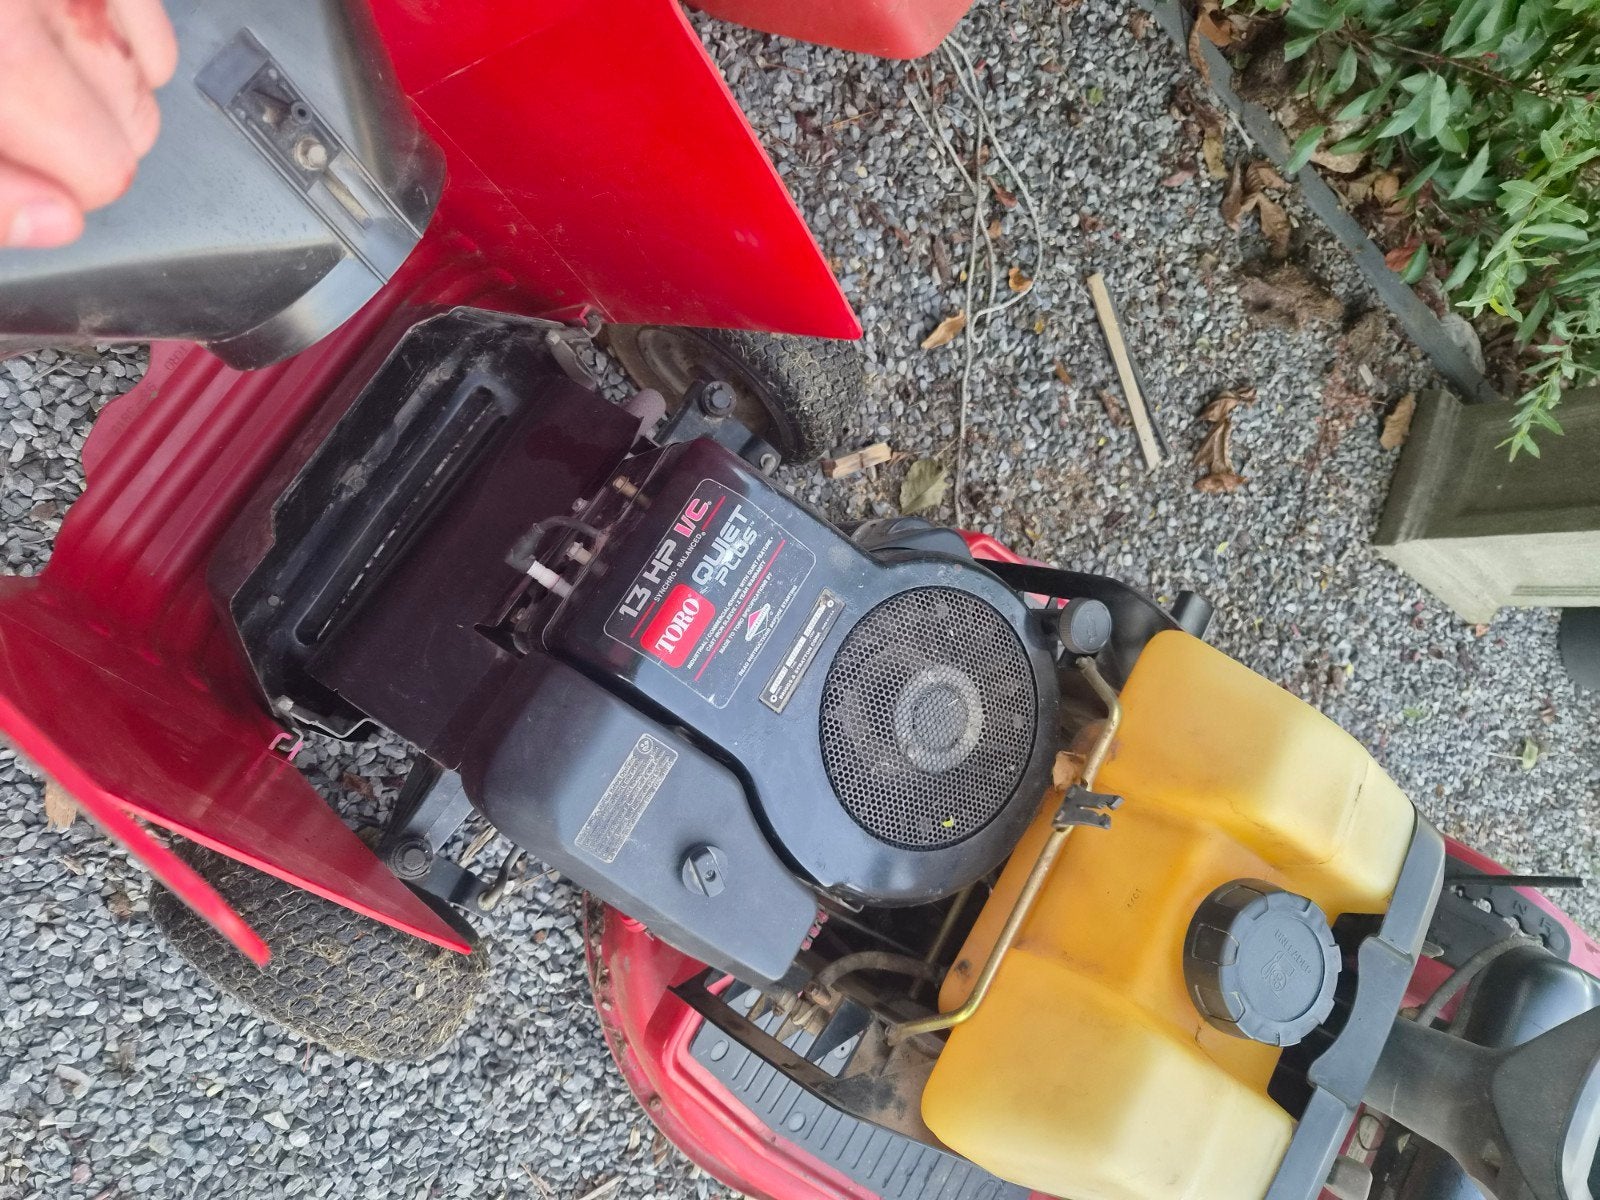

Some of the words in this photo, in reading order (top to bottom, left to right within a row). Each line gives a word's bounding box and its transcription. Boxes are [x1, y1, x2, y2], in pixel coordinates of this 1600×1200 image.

[619, 583, 652, 618] 13
[642, 538, 677, 584] HP
[653, 571, 677, 602] SYNCHRO
[676, 533, 702, 569] BALANCED
[691, 504, 749, 586] QUIET
[714, 531, 758, 587] PLUS
[655, 596, 701, 655] TORO
[687, 640, 707, 668] INDUSTRIAL
[739, 574, 749, 587] WITH
[747, 560, 758, 574] QUIET
[756, 538, 772, 560] FEATURE
[706, 639, 715, 651] CAST
[714, 625, 724, 637] IRON
[722, 607, 736, 625] SLEEVE
[739, 587, 748, 599] YEAR
[747, 560, 765, 586] WARRANTY
[719, 639, 730, 653] MADE
[733, 617, 743, 631] TORO
[742, 579, 768, 617] SPECIFICATIONS
[738, 662, 749, 675] READ
[747, 627, 770, 661] INSTRUCTIONS
[769, 608, 782, 627] BEFORE
[781, 585, 797, 607] STARTING
[794, 646, 813, 673] STRATTON
